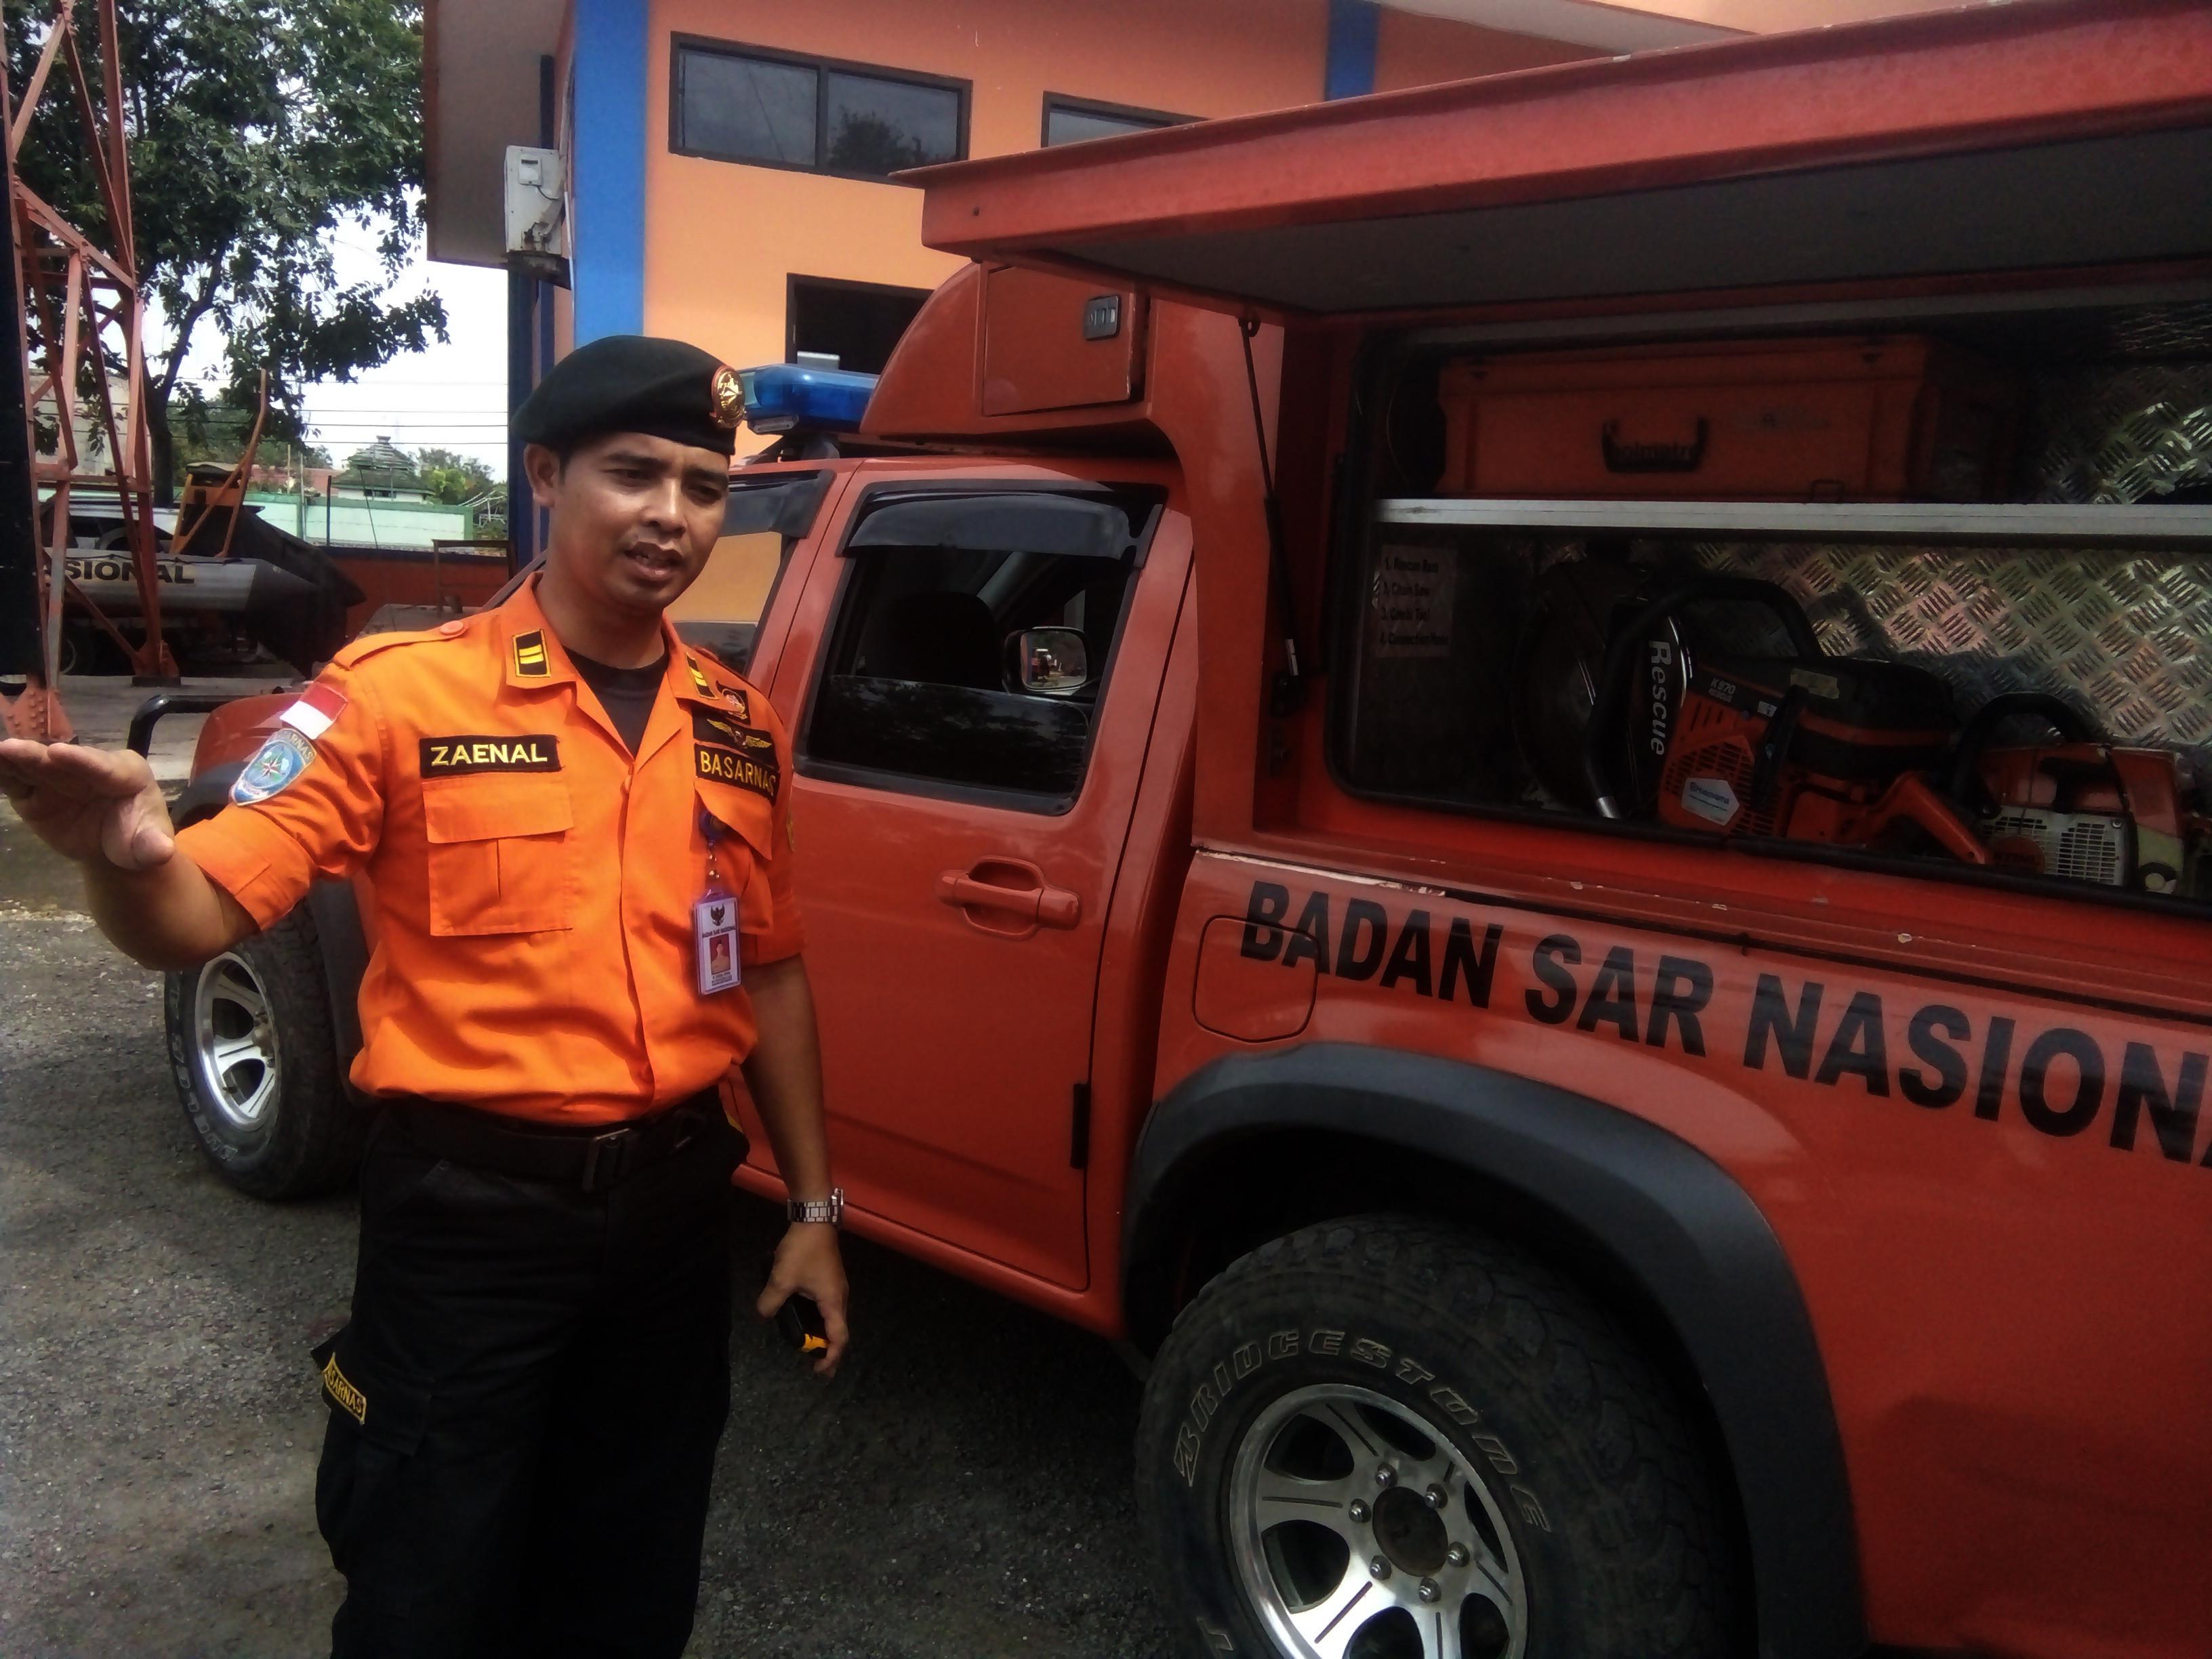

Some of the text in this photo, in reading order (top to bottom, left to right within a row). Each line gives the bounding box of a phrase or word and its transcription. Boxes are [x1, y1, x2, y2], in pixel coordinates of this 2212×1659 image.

[431, 743, 548, 766] ZAENAL
[1648, 640, 1672, 756] Rescue
[700, 750, 776, 797] BASARNAS
[1240, 881, 2212, 1169] BADAN SAR NASION
[1173, 1328, 1551, 1534] BRIDGESTONE
